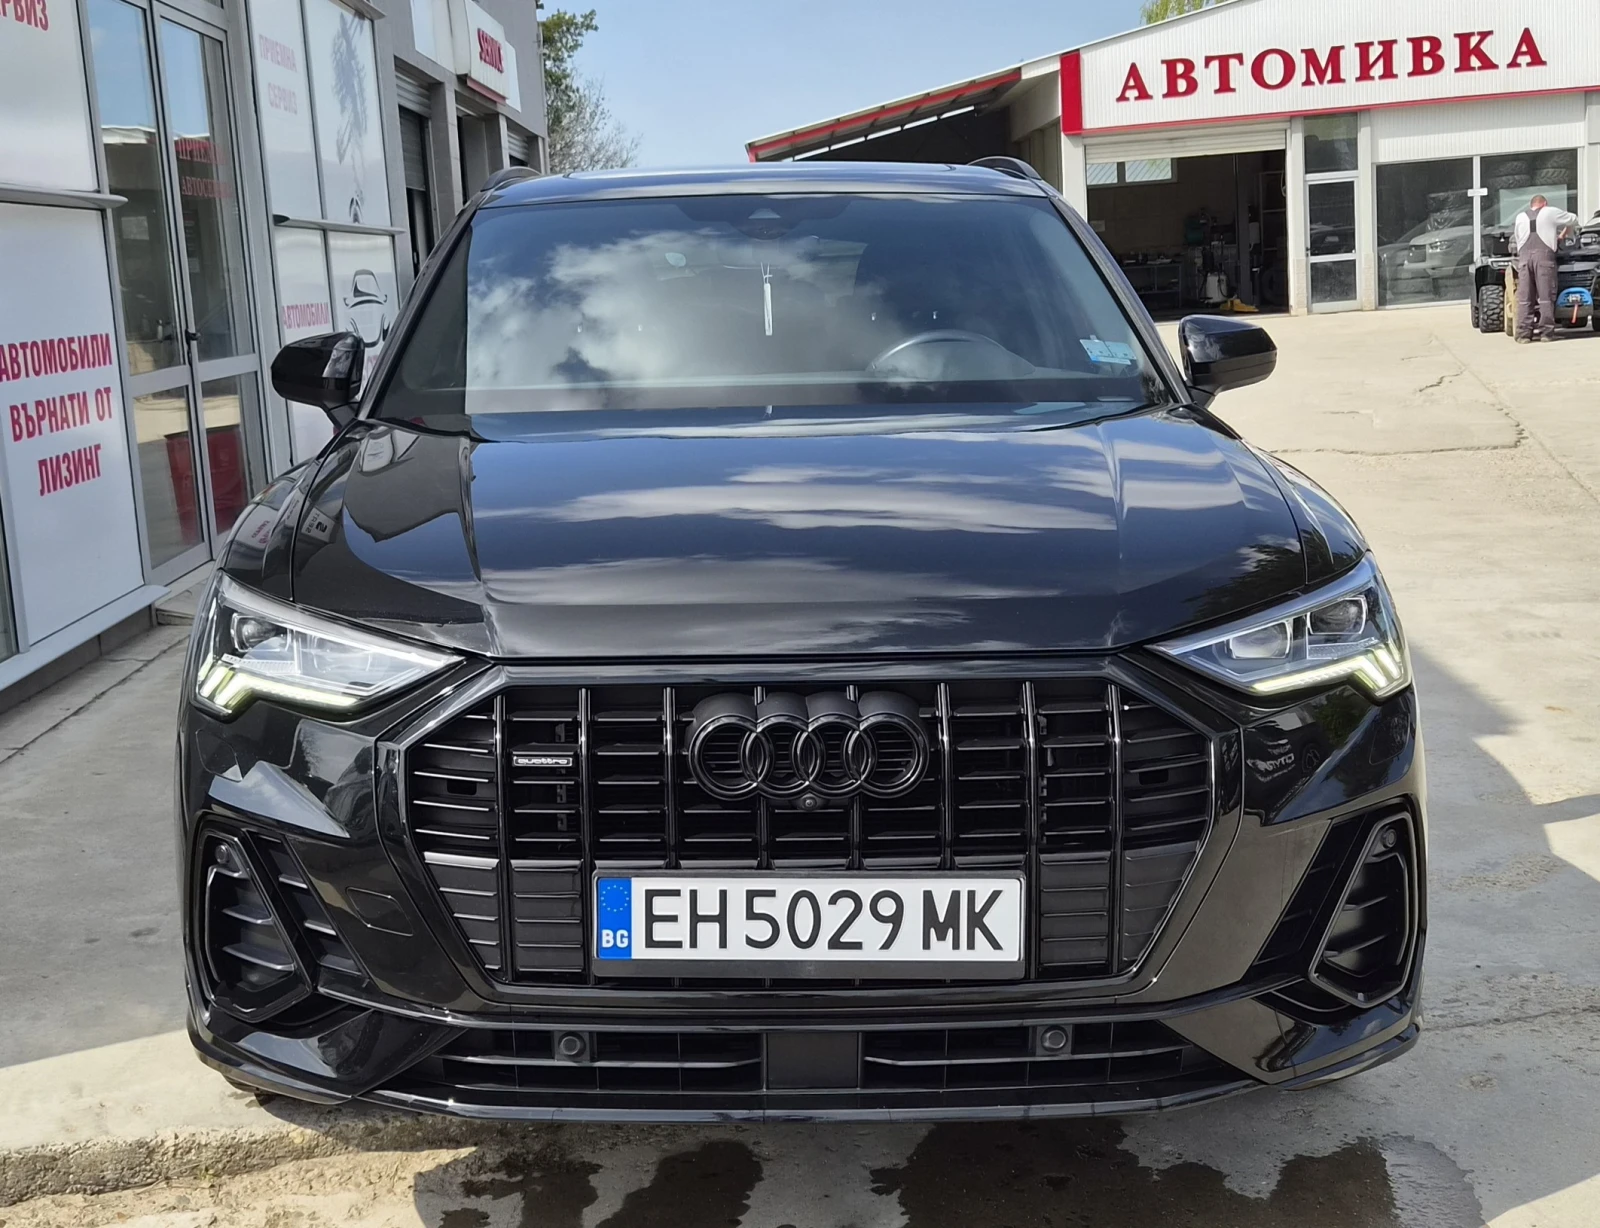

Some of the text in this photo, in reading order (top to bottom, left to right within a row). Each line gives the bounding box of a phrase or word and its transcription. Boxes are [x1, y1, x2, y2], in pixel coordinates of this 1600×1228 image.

[1116, 27, 1547, 103] АВТОМИВКА
[282, 302, 330, 329] АВТОМОБИЛИ
[0, 333, 112, 383] АВТОМОБИЛИ
[9, 386, 112, 443] ВЪРНАТИ ОТ
[38, 443, 102, 497] ЛИЗИНГ
[601, 929, 629, 948] BG
[645, 888, 1004, 951] EH 5029 MK
